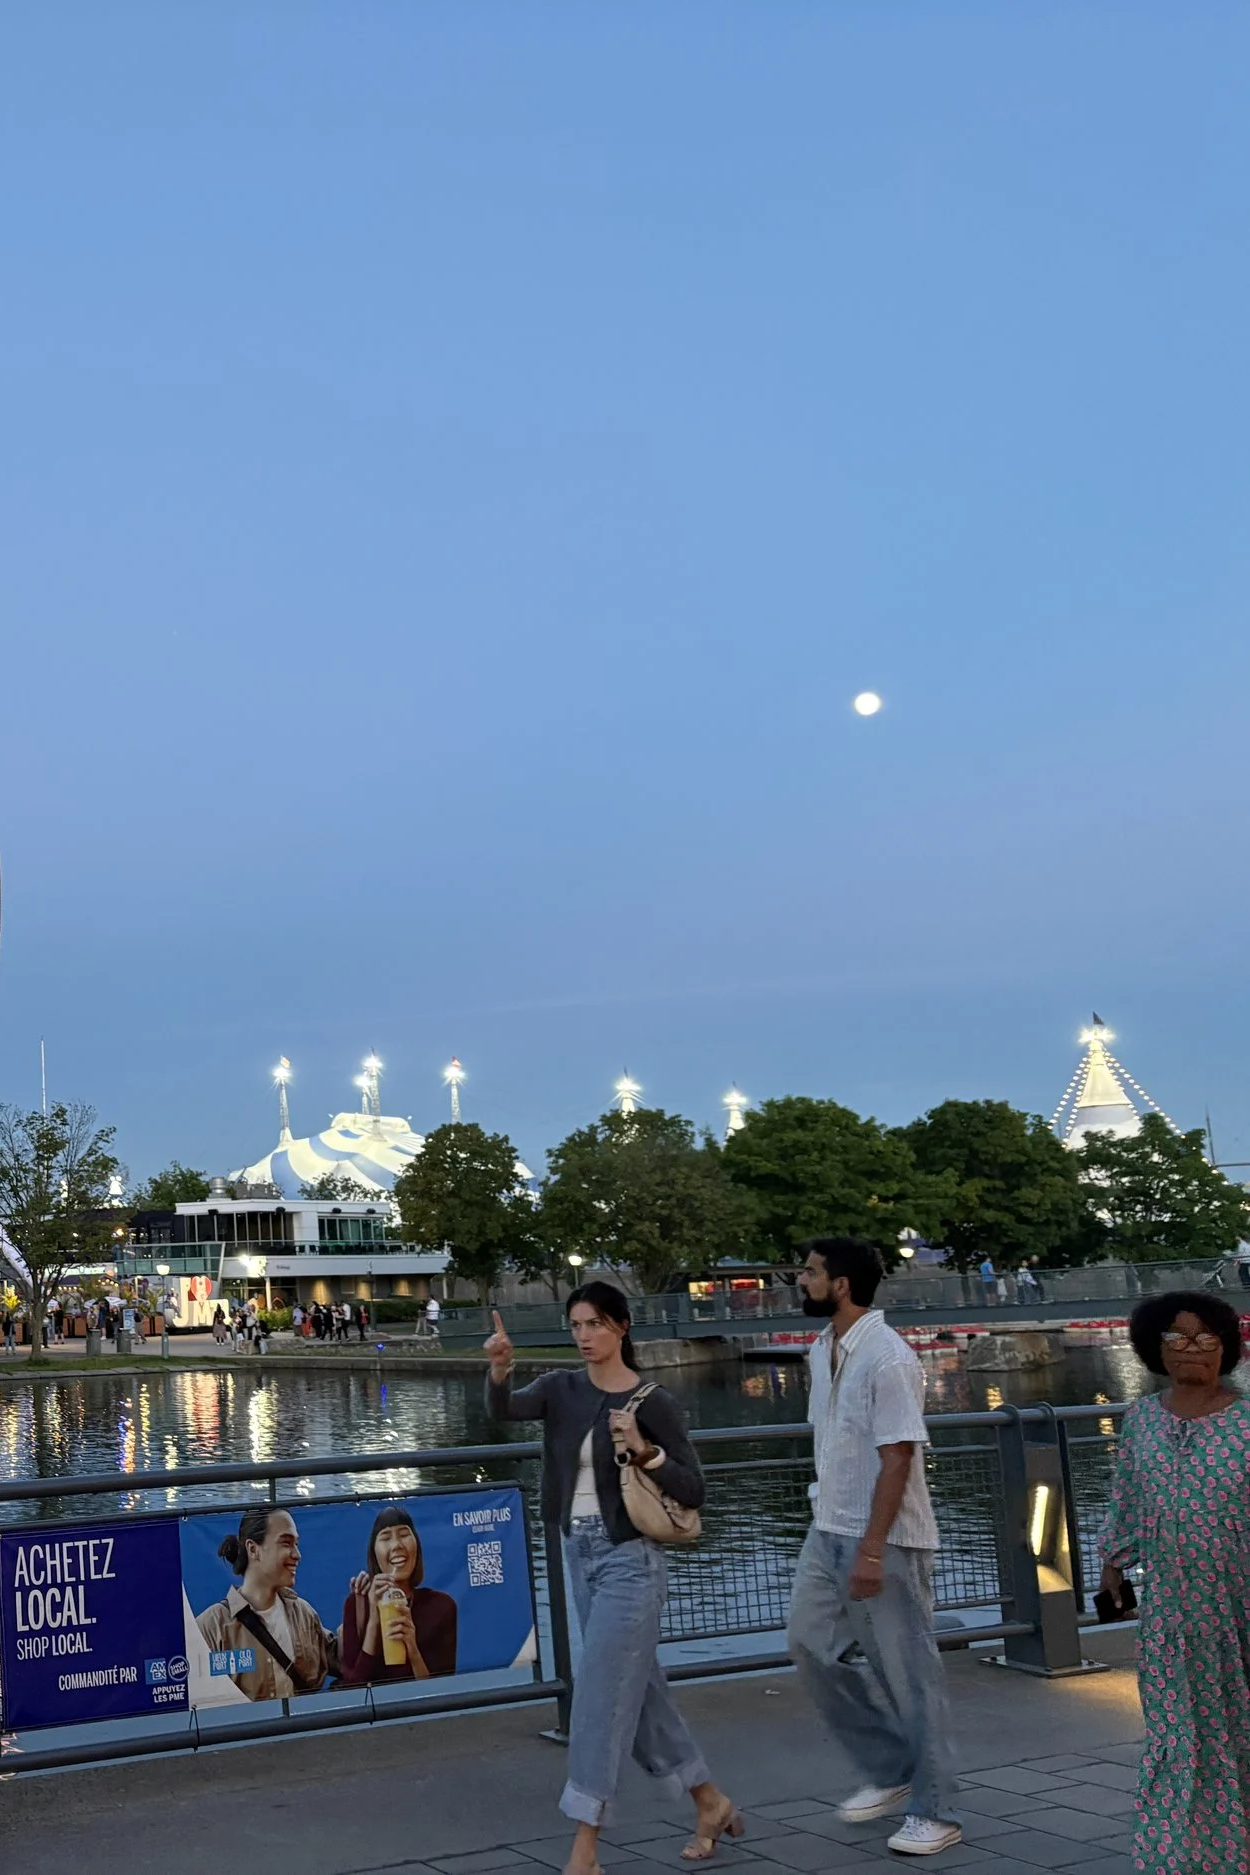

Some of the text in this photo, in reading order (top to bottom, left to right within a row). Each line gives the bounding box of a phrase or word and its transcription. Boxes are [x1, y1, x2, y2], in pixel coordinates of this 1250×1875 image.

[453, 1507, 511, 1527] EN SAVOIR PLUS
[14, 1538, 116, 1587] ACHETEZ
[15, 1585, 97, 1632] LOCAL.
[16, 1632, 93, 1660] SHOP LOCAL.
[58, 1665, 138, 1691] COMMANDITÉ PAR
[152, 1684, 186, 1695] APPUYEZ
[153, 1692, 185, 1703] LES PME
